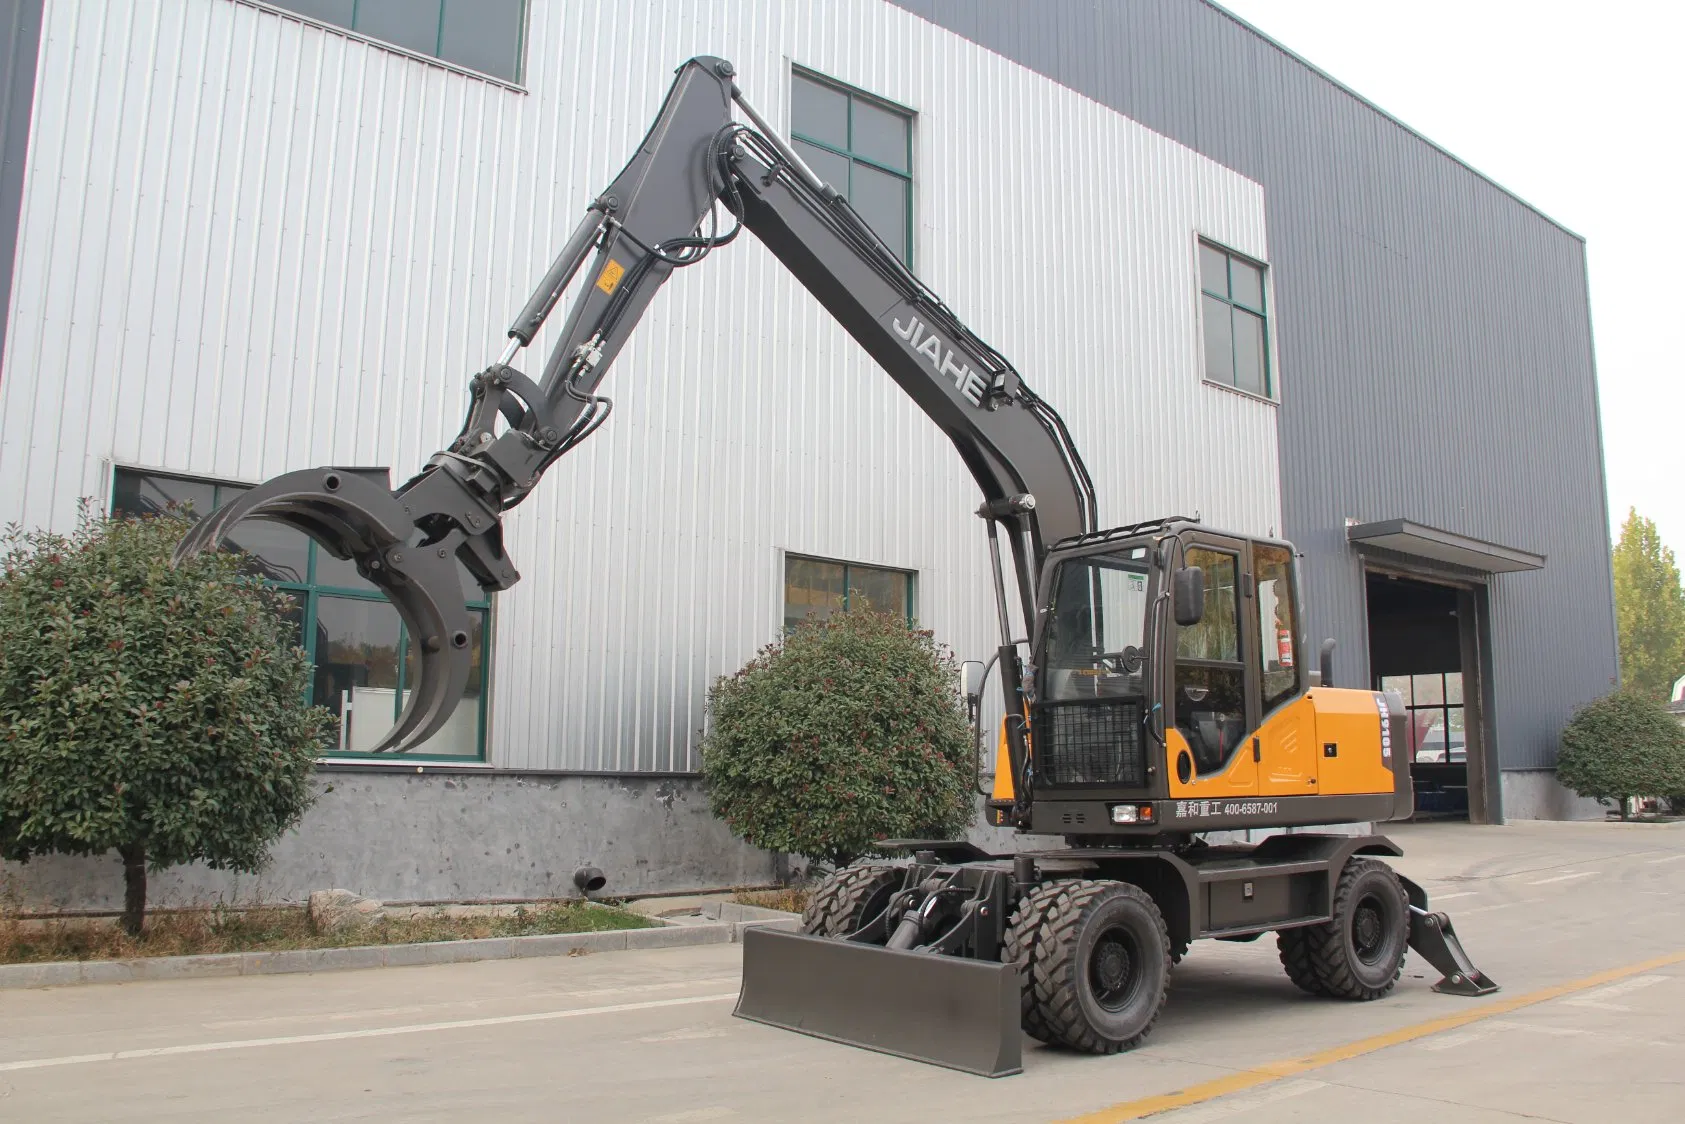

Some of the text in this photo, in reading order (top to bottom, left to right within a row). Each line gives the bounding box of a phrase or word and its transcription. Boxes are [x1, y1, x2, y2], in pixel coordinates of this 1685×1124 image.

[892, 316, 988, 408] JIAHE
[1376, 698, 1391, 757] JH9105
[1175, 801, 1278, 818] 嘉和重工 400-6587-001
